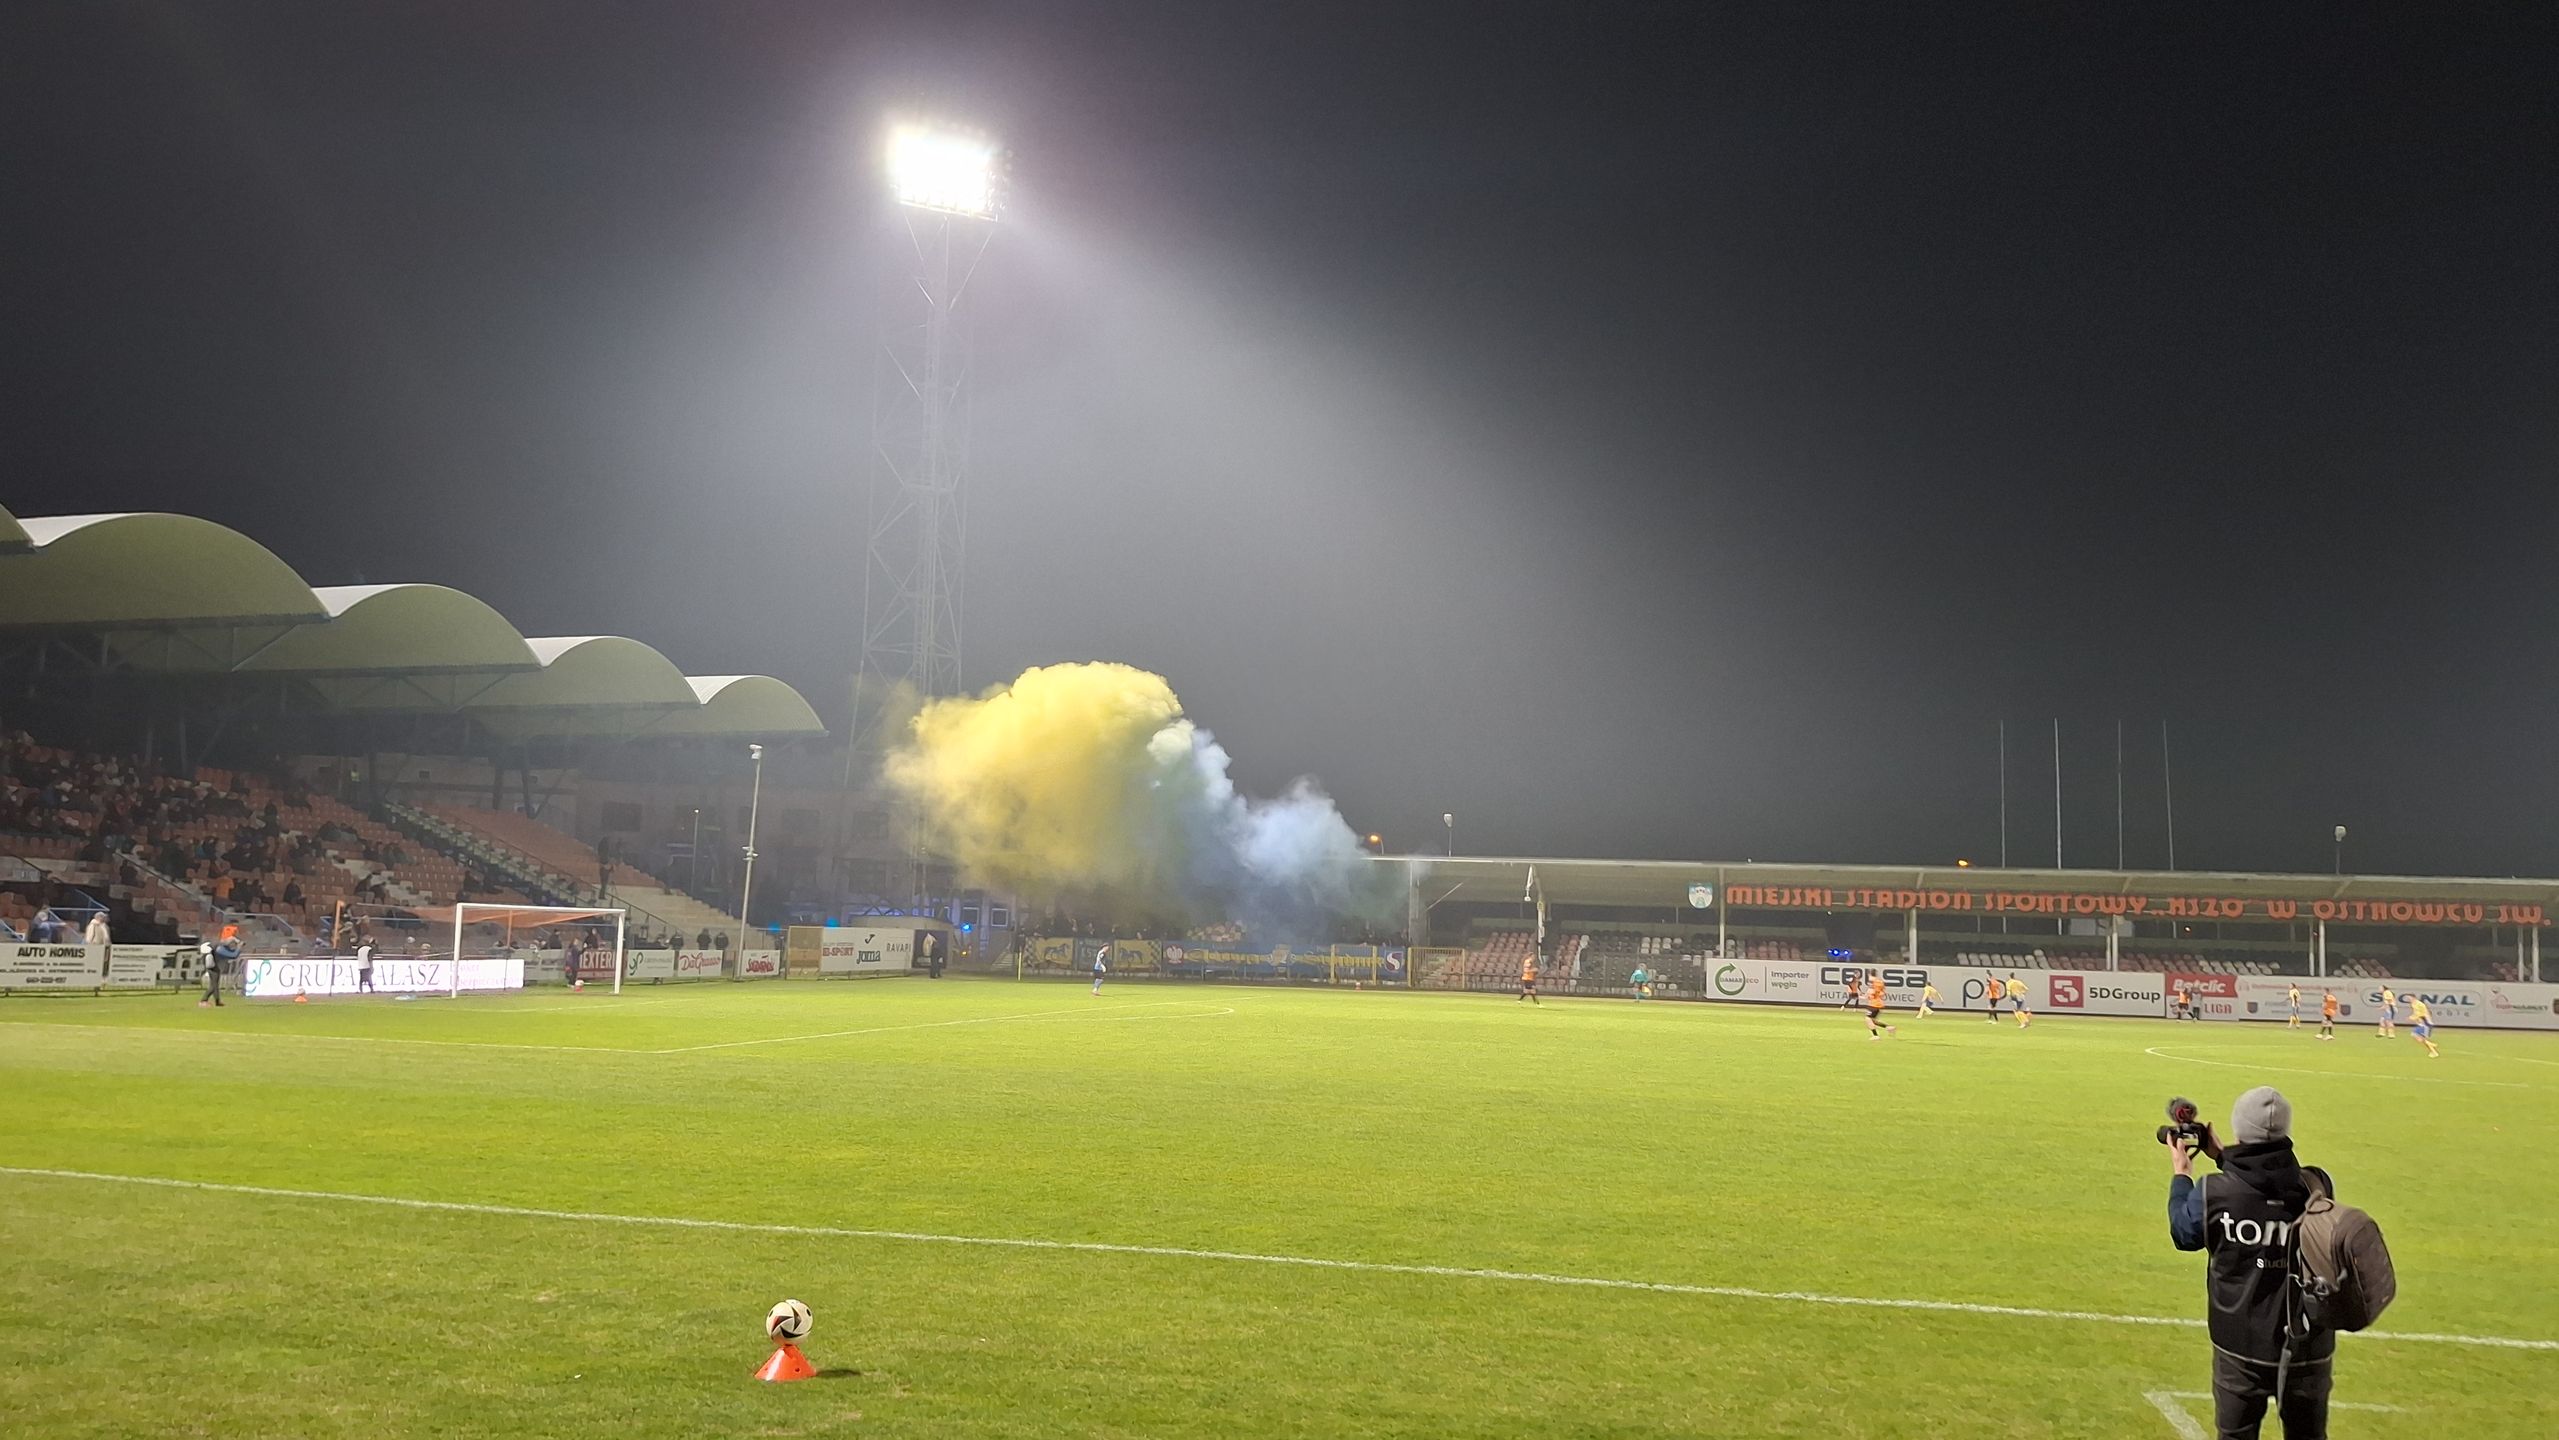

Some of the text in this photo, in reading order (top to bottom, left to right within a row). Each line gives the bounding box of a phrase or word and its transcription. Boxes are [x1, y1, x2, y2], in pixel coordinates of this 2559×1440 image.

[1726, 886, 1832, 907] MIEJSKI
[1845, 887, 1971, 911] STADION
[1984, 890, 2147, 915] SPORTOWY
[2266, 898, 2297, 920] W
[2313, 900, 2484, 923] OSTROWCU
[17, 947, 85, 958] AUTO KOMIS
[279, 963, 356, 987] GRUPA
[1771, 970, 1809, 981] Importer
[2173, 978, 2226, 993] Betclic
[2368, 992, 2475, 1006] SGNAL
